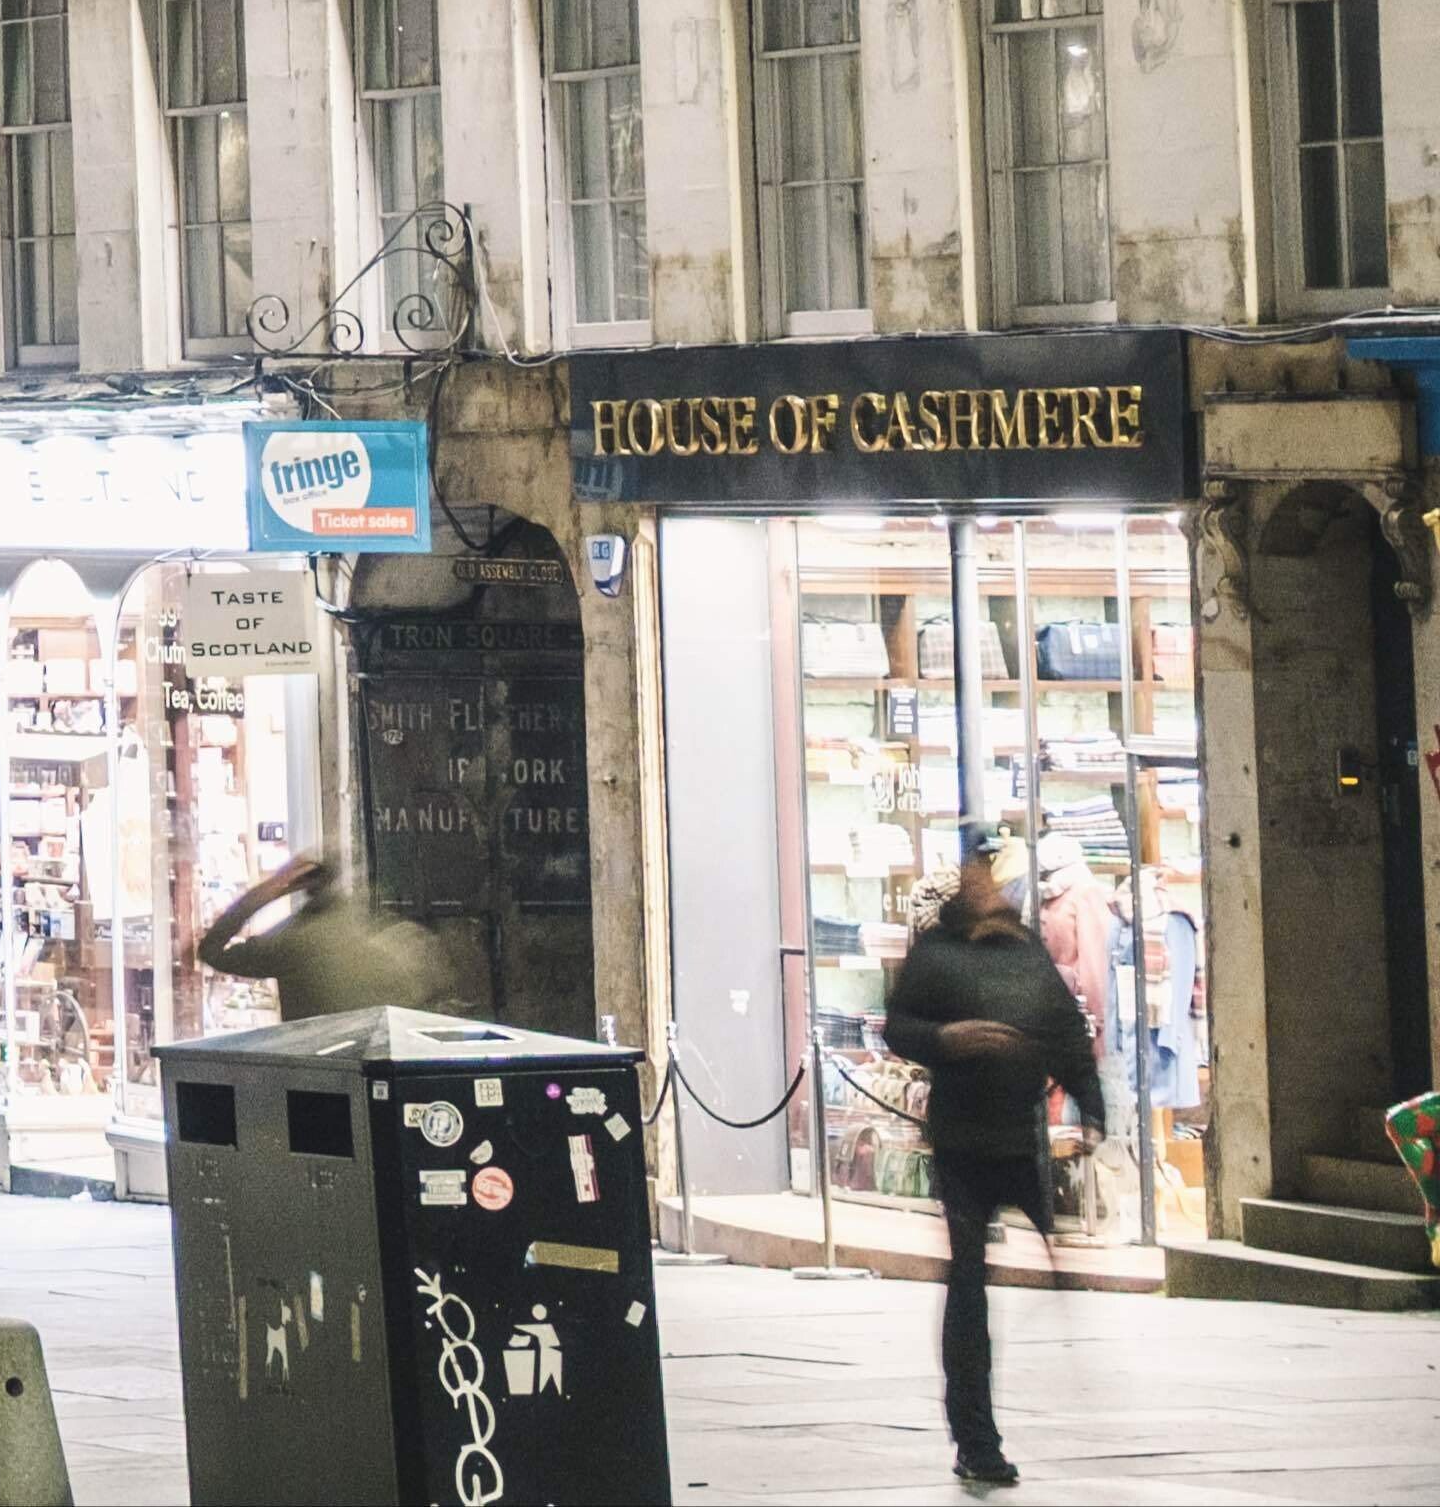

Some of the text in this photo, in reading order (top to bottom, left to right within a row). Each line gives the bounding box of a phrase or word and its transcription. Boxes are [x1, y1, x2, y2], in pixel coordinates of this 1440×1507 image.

[590, 385, 1144, 456] HOUSE OF CASHMERE
[270, 450, 361, 495] fringe
[317, 512, 408, 529] Ticket sales
[480, 562, 524, 582] ASSEMBLY
[529, 563, 560, 583] CLOSE
[211, 591, 283, 605] TASTE
[236, 617, 264, 631] OF
[390, 624, 556, 648] TRON SQUARE
[191, 641, 313, 657] SCOTLAND
[162, 681, 245, 713] Tea, Coffee
